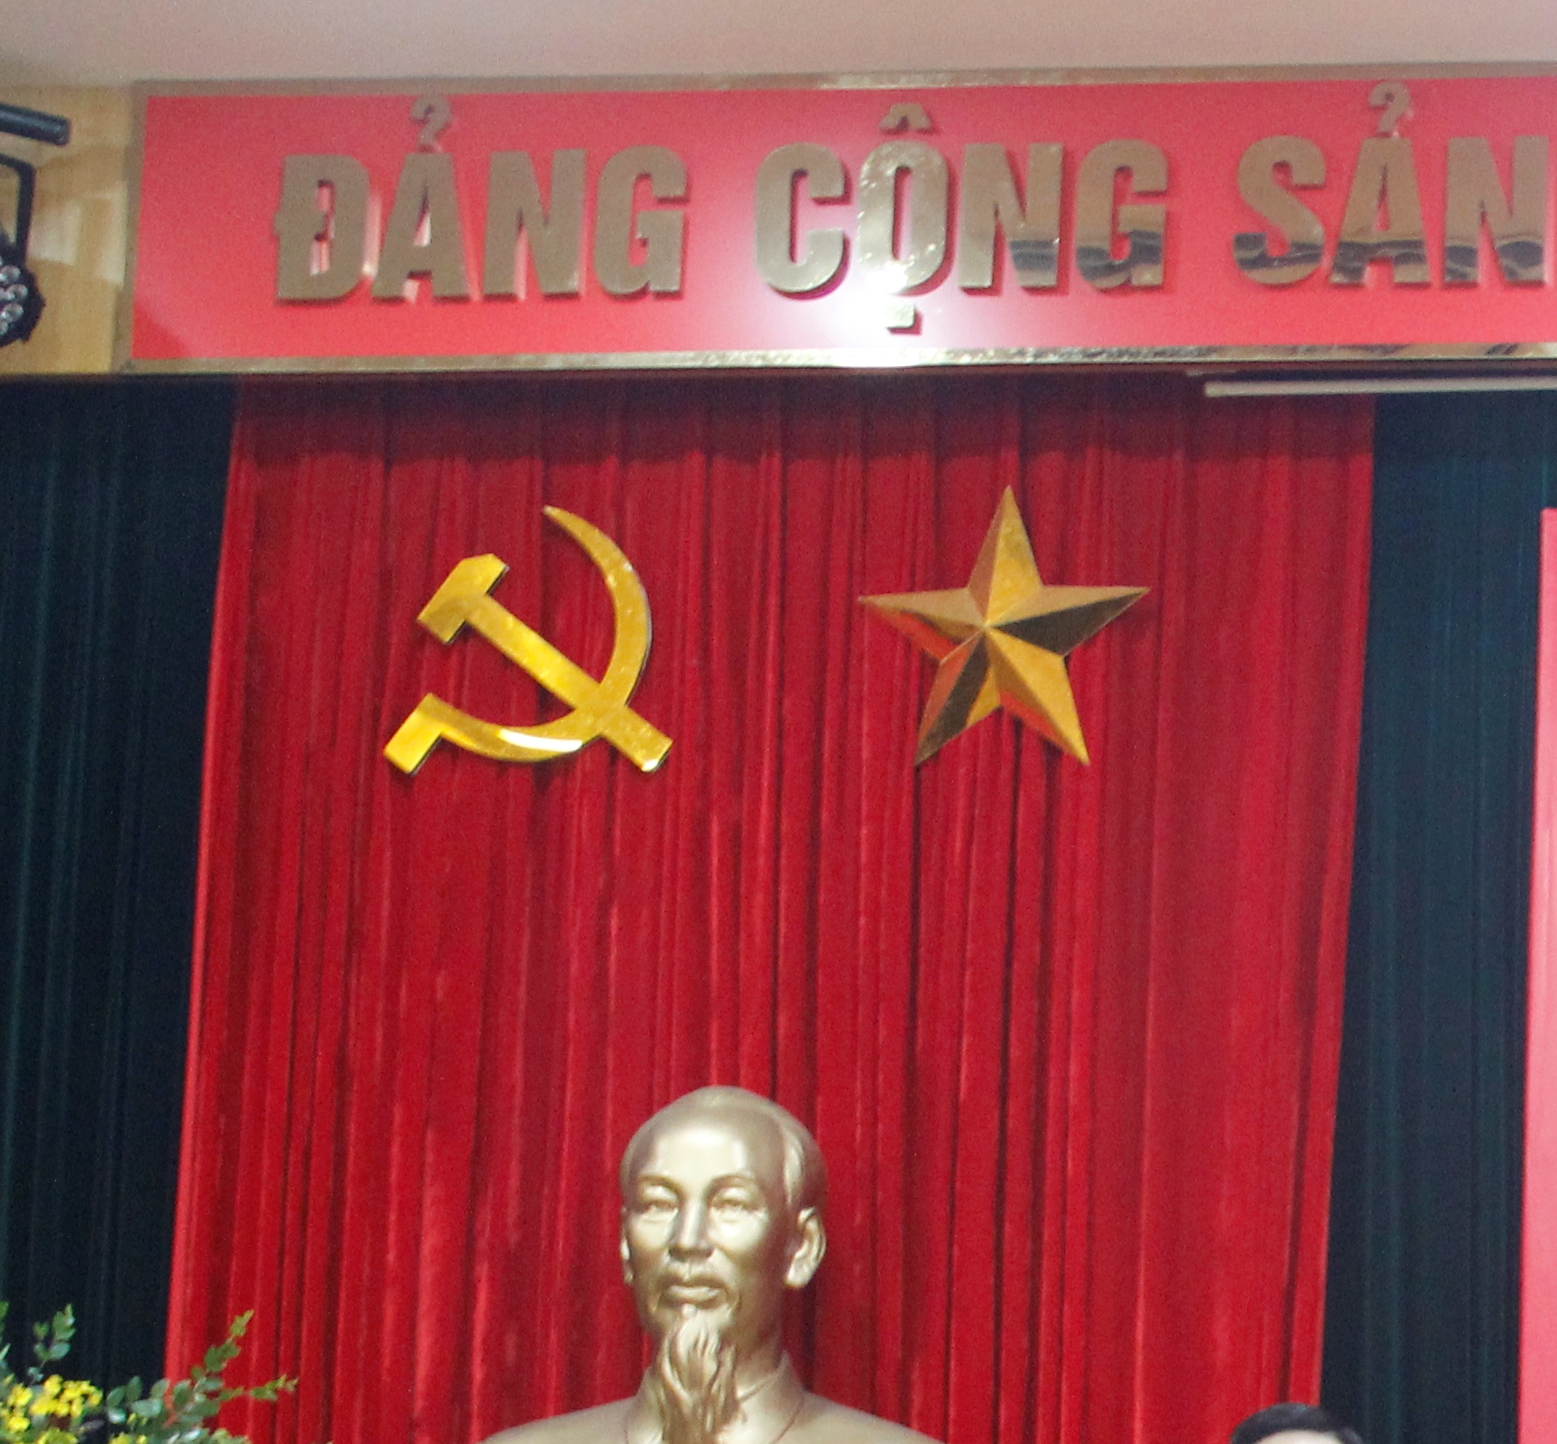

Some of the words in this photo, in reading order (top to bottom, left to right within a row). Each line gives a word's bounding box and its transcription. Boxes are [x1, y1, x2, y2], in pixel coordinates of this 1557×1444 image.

[272, 96, 690, 302] ĐẢNG
[752, 101, 1170, 330] CỘNG
[1231, 81, 1550, 288] SẢN
